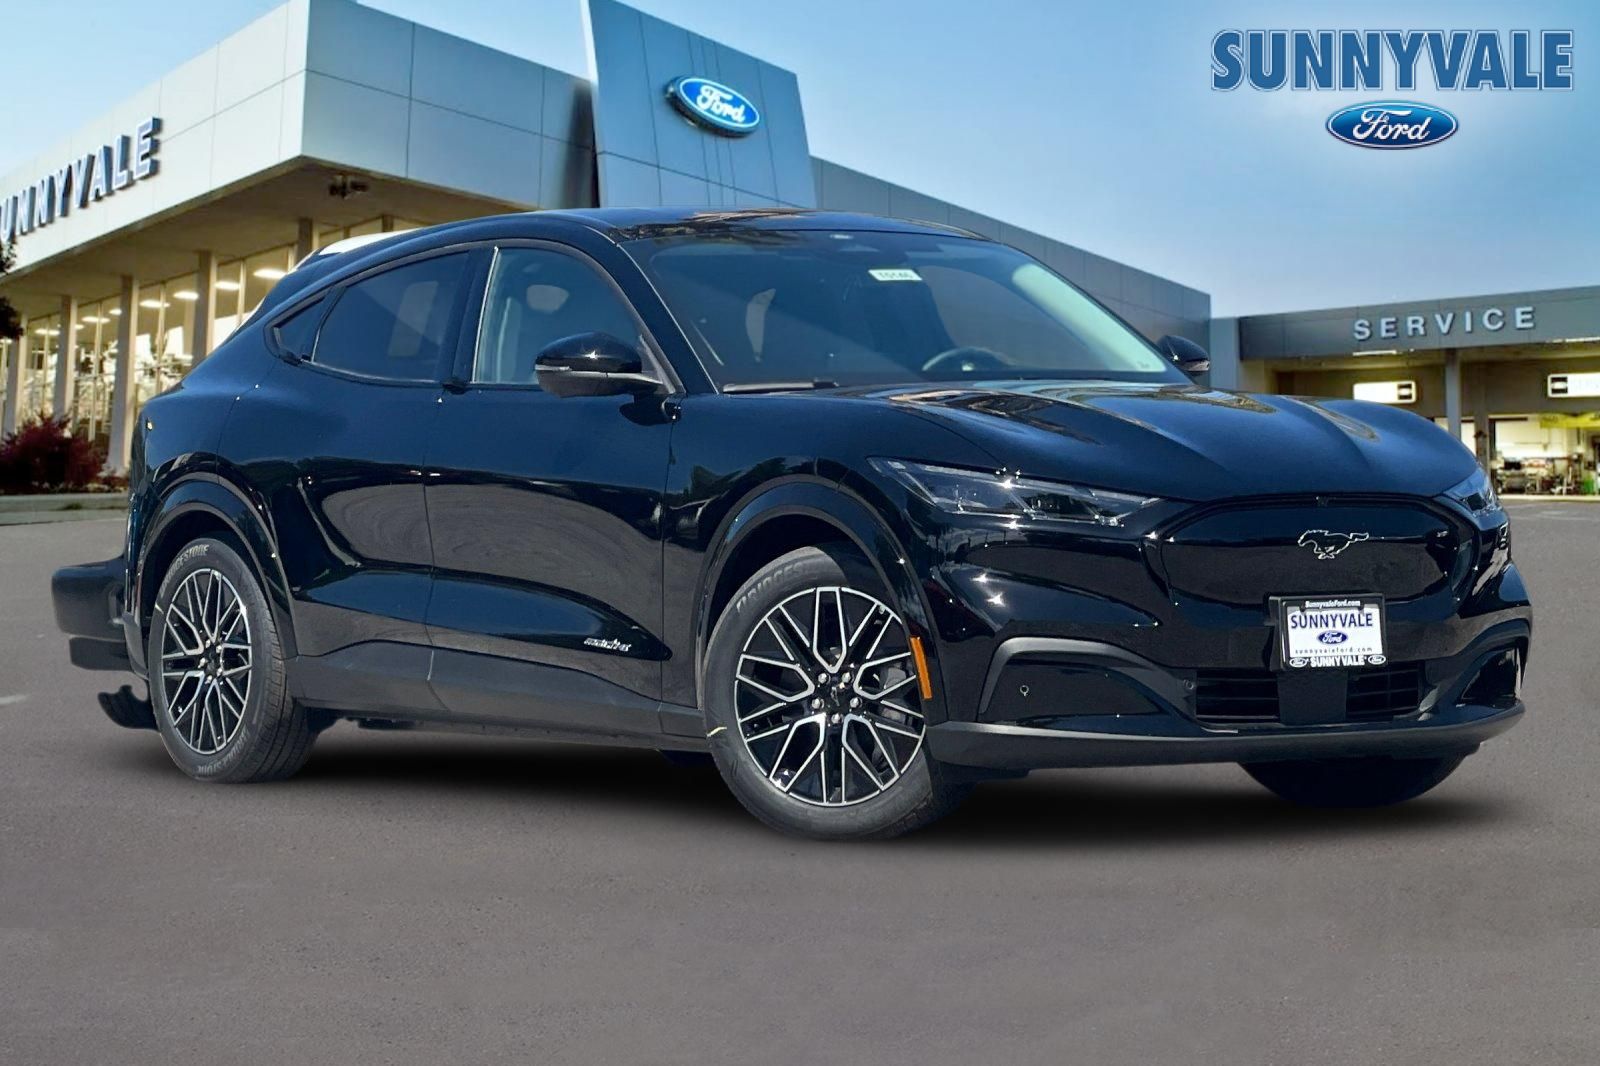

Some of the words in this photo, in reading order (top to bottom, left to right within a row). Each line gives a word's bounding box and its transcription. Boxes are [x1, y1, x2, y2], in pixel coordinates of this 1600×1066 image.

[696, 85, 744, 122] Ford
[0, 117, 161, 244] UNNYVALE
[1353, 306, 1536, 341] SERVICE
[1291, 613, 1373, 629] SUNNYVALE
[1310, 655, 1365, 667] SUNNYVALE
